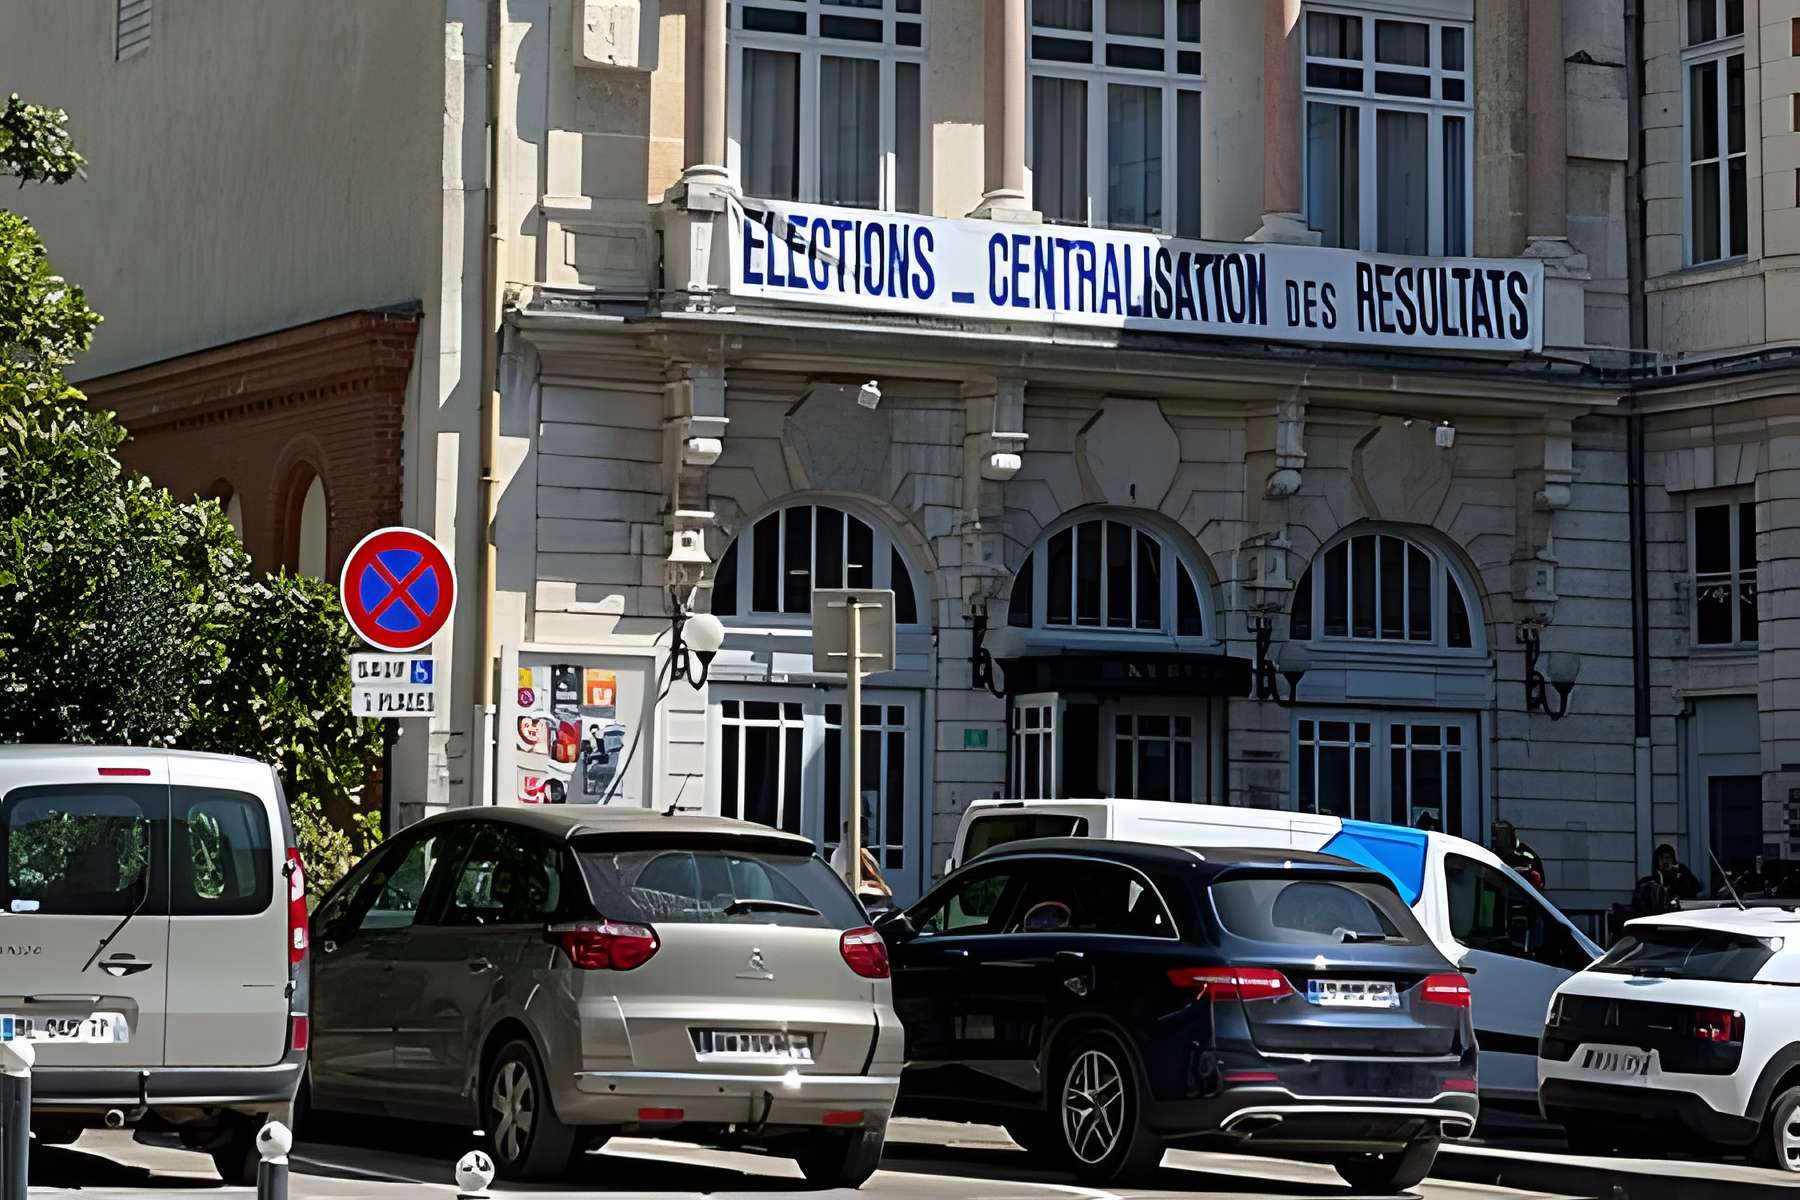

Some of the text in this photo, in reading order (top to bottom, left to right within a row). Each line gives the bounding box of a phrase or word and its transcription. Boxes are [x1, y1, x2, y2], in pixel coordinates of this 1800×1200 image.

[743, 208, 935, 300] ELECTIONS
[989, 232, 1268, 326] CENTRALISATION
[1286, 279, 1337, 329] DES
[1356, 261, 1529, 340] RESULTATS
